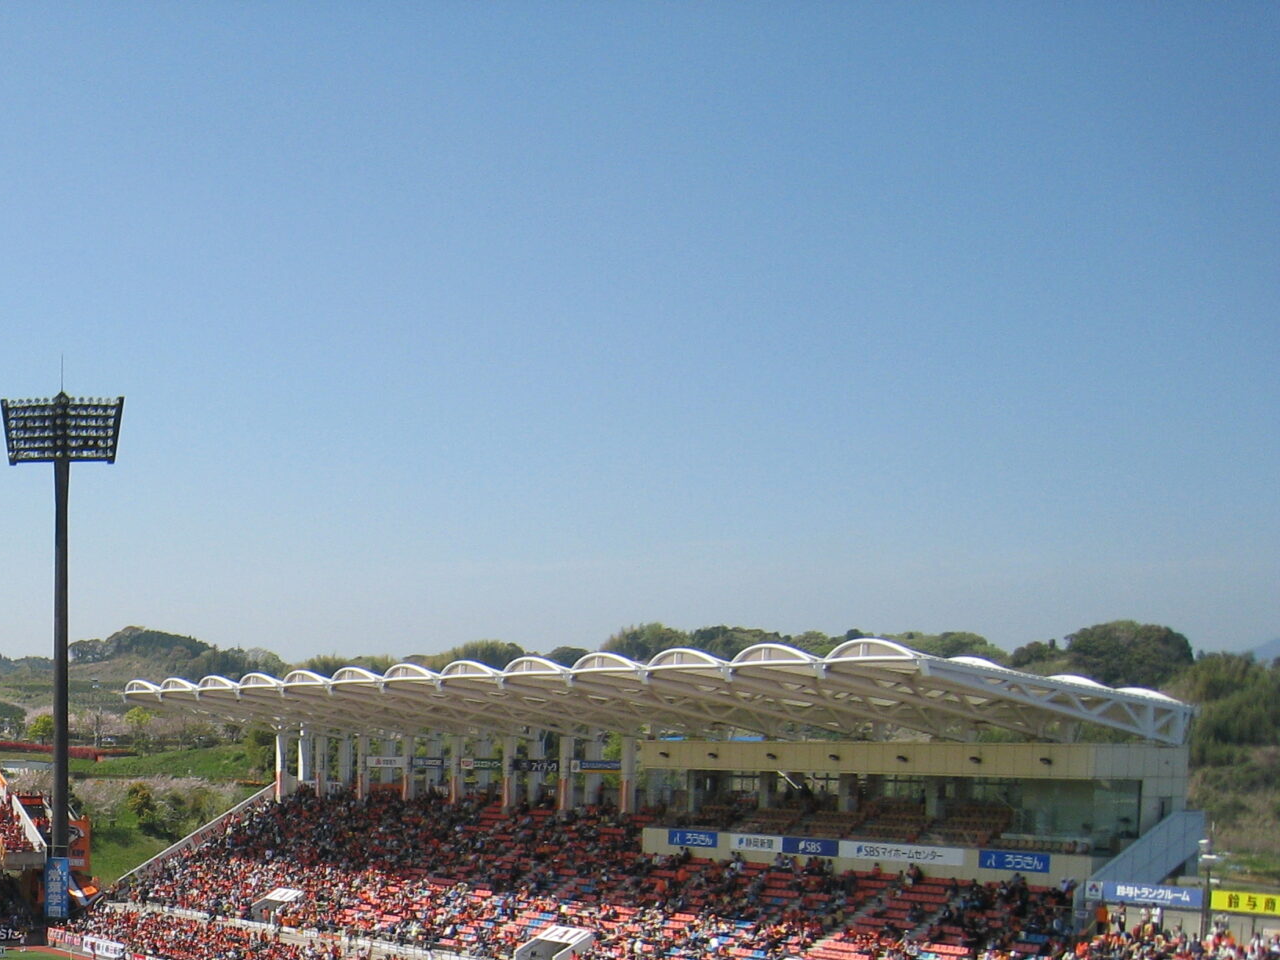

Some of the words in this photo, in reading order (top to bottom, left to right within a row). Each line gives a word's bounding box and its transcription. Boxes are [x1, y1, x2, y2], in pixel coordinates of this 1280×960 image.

[686, 833, 712, 845] ろうきん
[806, 842, 821, 852] SBS
[864, 846, 944, 860] SBSマイホームセンター
[1004, 855, 1043, 869] ろうきん
[1117, 885, 1190, 902] 鈴与トランクルーム
